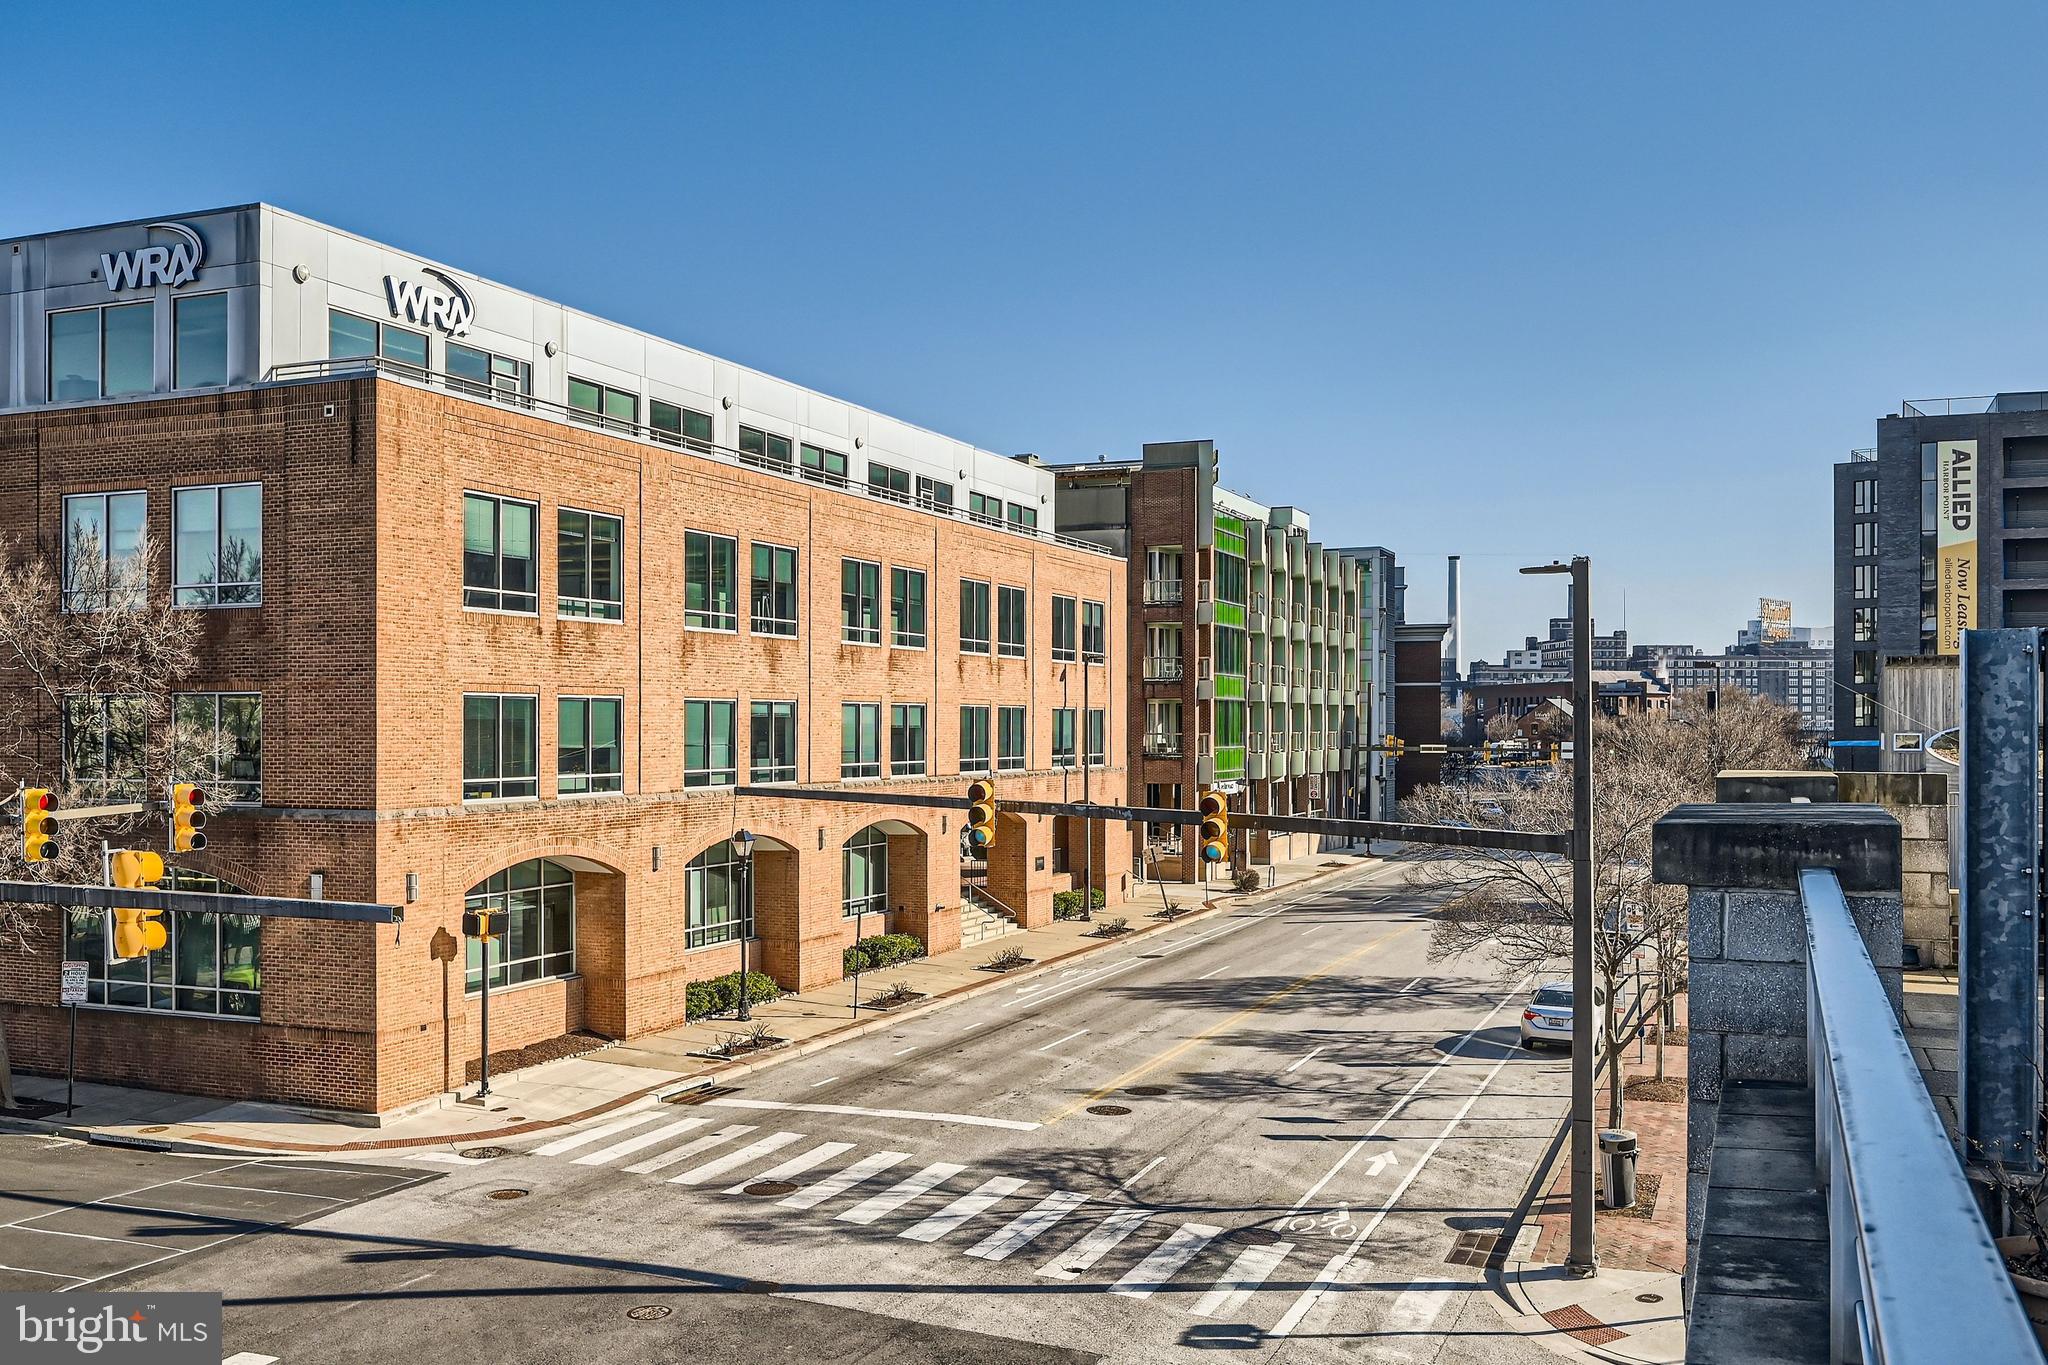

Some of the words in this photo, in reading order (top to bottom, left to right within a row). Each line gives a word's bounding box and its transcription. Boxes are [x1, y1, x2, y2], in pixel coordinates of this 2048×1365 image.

[100, 242, 199, 292] WRA
[383, 274, 473, 338] WRA
[1942, 460, 1950, 493] HARBOR
[1952, 448, 1971, 531] ALLIED
[1957, 558, 1971, 591] Now
